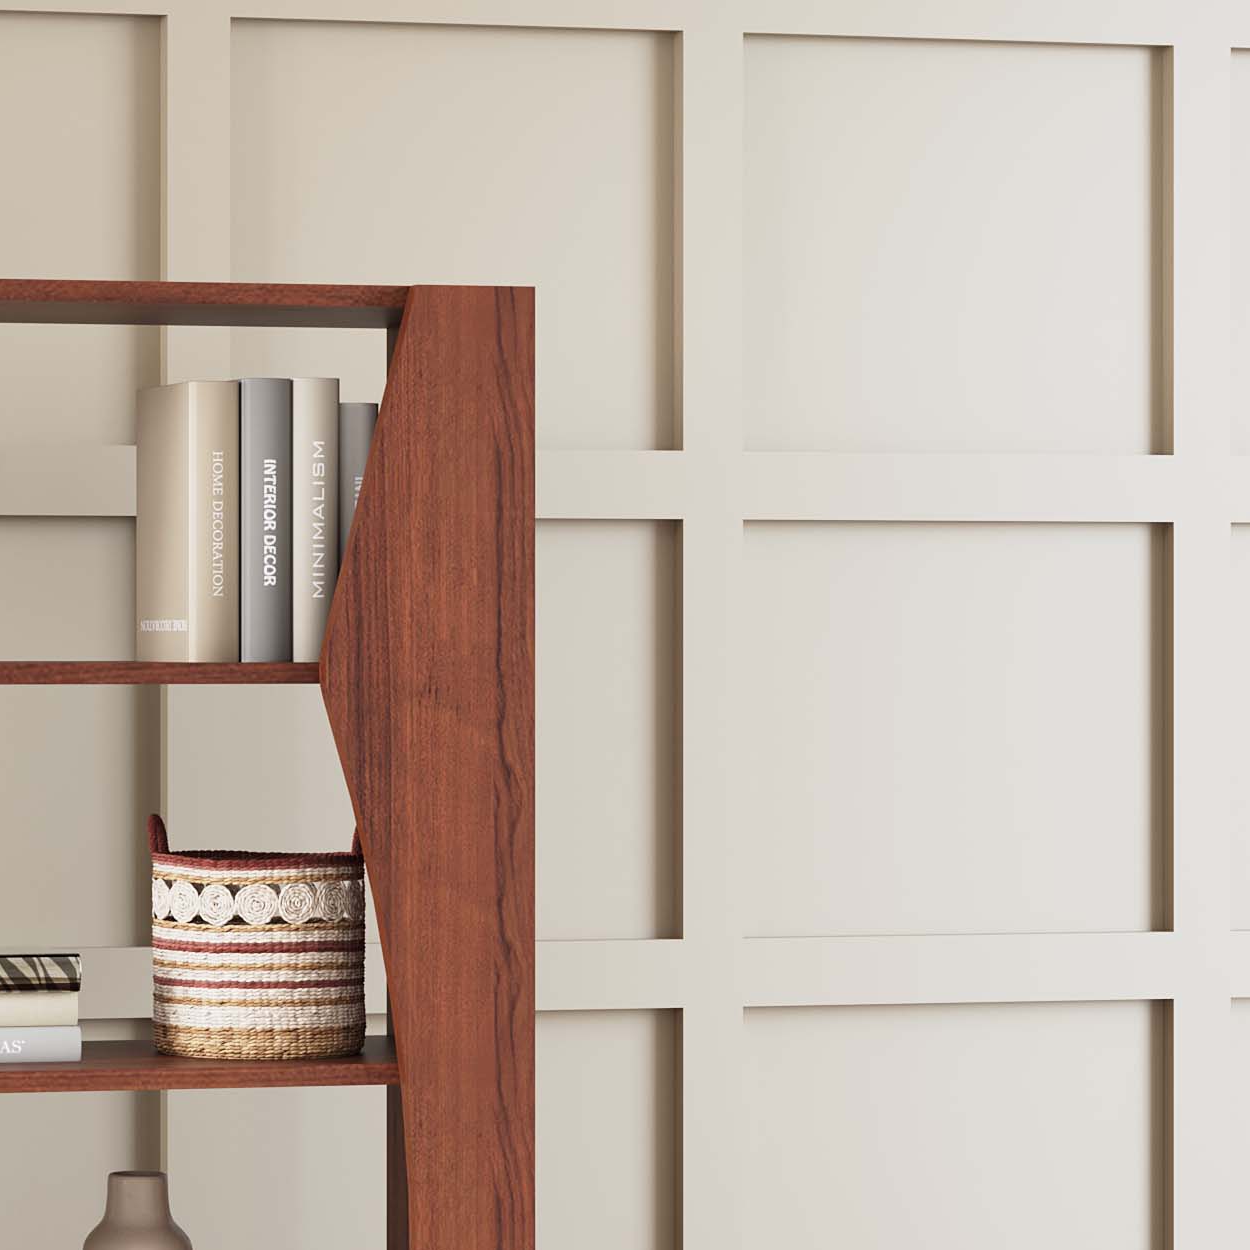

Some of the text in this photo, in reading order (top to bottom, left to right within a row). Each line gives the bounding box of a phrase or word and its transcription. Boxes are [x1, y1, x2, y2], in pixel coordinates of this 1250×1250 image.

[212, 451, 224, 597] HOME DECORATION
[263, 459, 277, 586] INTERIOR DECOR
[311, 441, 325, 598] MINIMALISM
